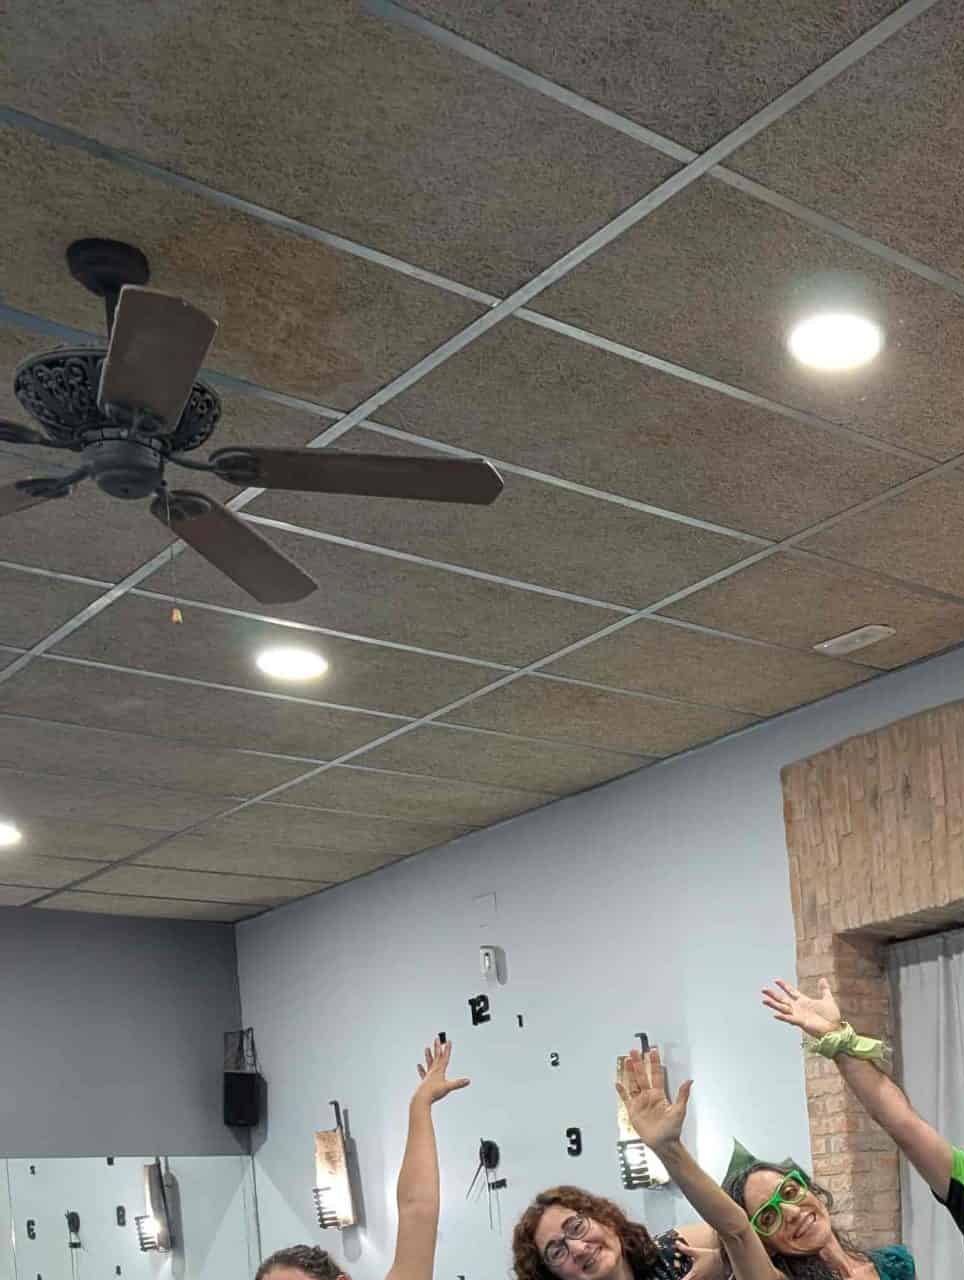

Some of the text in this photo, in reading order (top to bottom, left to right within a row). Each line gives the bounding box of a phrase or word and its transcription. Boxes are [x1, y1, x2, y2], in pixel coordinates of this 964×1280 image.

[468, 994, 491, 1026] 12
[516, 1014, 524, 1028] 1
[550, 1052, 560, 1067] 2
[566, 1127, 583, 1157] 3
